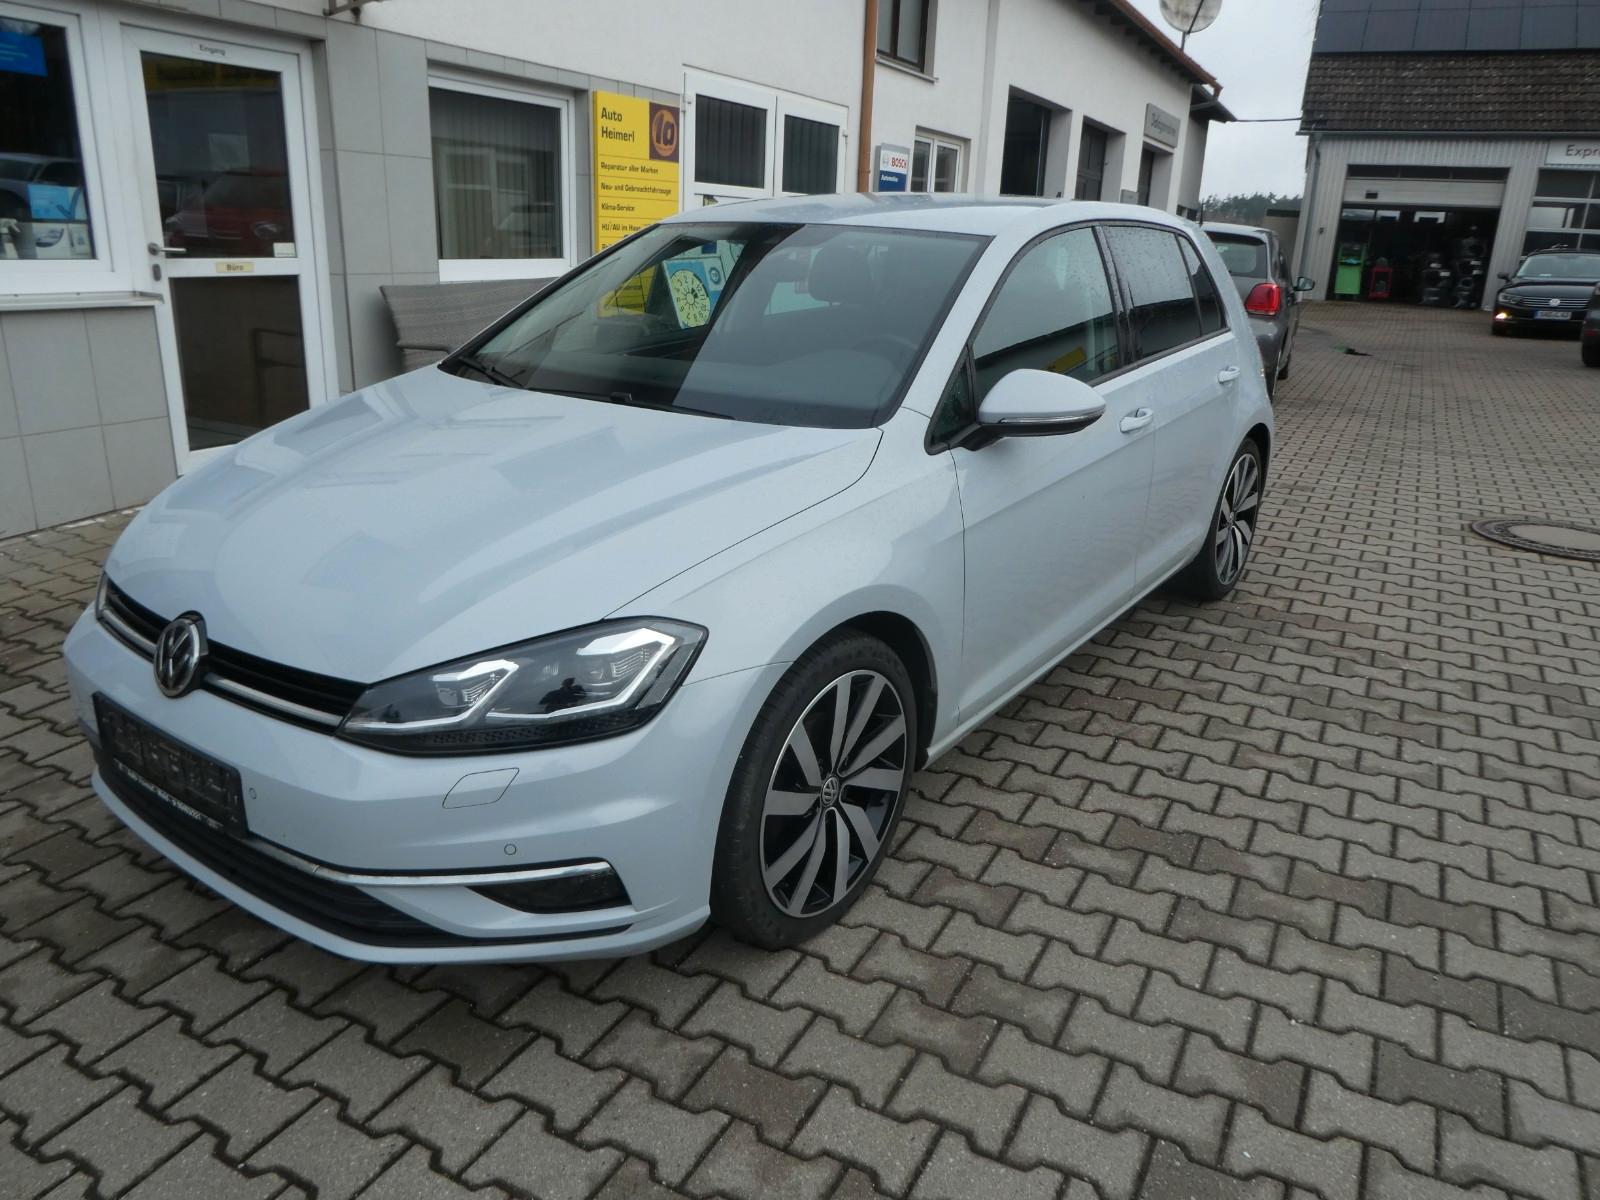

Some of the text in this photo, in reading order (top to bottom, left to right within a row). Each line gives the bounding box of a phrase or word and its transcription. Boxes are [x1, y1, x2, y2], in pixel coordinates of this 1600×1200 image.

[601, 107, 623, 122] Auto
[601, 126, 635, 142] Heimerl
[600, 161, 659, 174] Reparatur aller Marken
[891, 156, 908, 169] BOSCH
[226, 264, 244, 272] Büro
